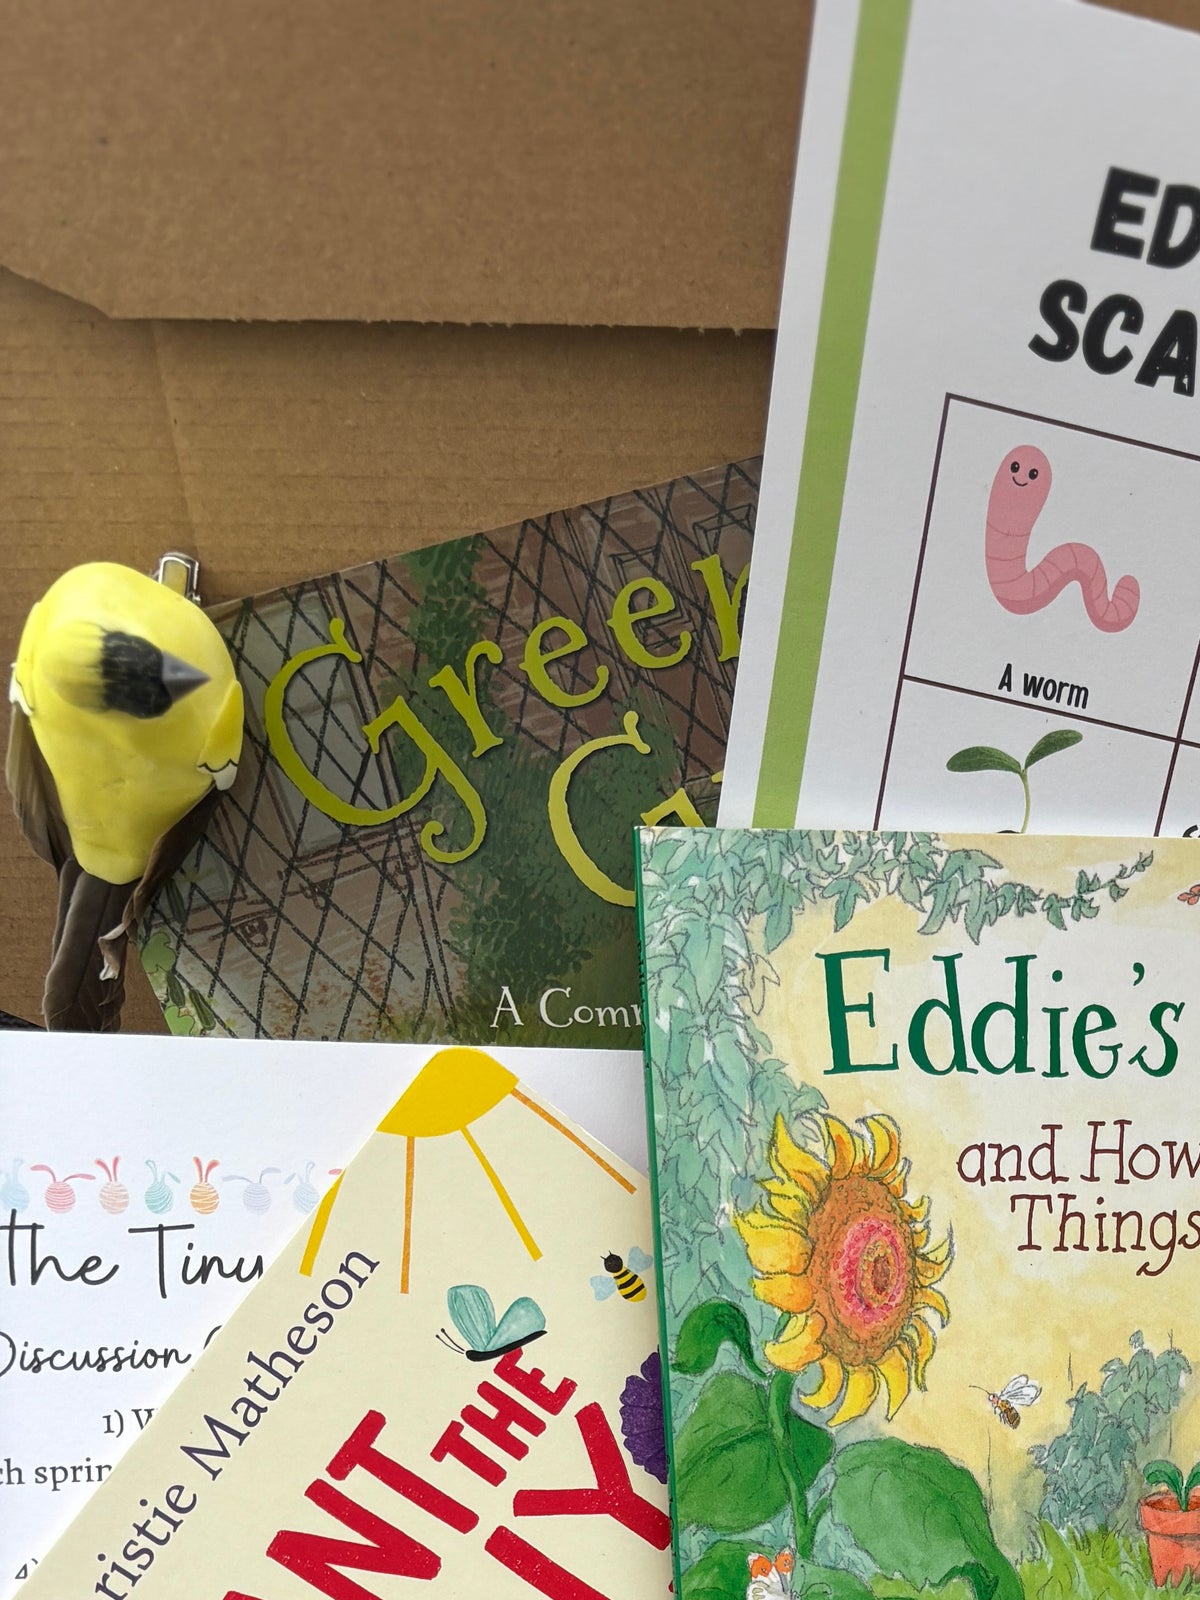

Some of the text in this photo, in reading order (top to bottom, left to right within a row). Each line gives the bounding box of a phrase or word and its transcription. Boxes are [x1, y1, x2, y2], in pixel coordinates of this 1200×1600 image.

[998, 663, 1090, 710] A worm
[490, 986, 525, 1029] A
[816, 948, 1185, 1080] Eddie's
[956, 1123, 1064, 1187] and
[179, 1249, 380, 1483] Matheson
[429, 1346, 579, 1487] THE
